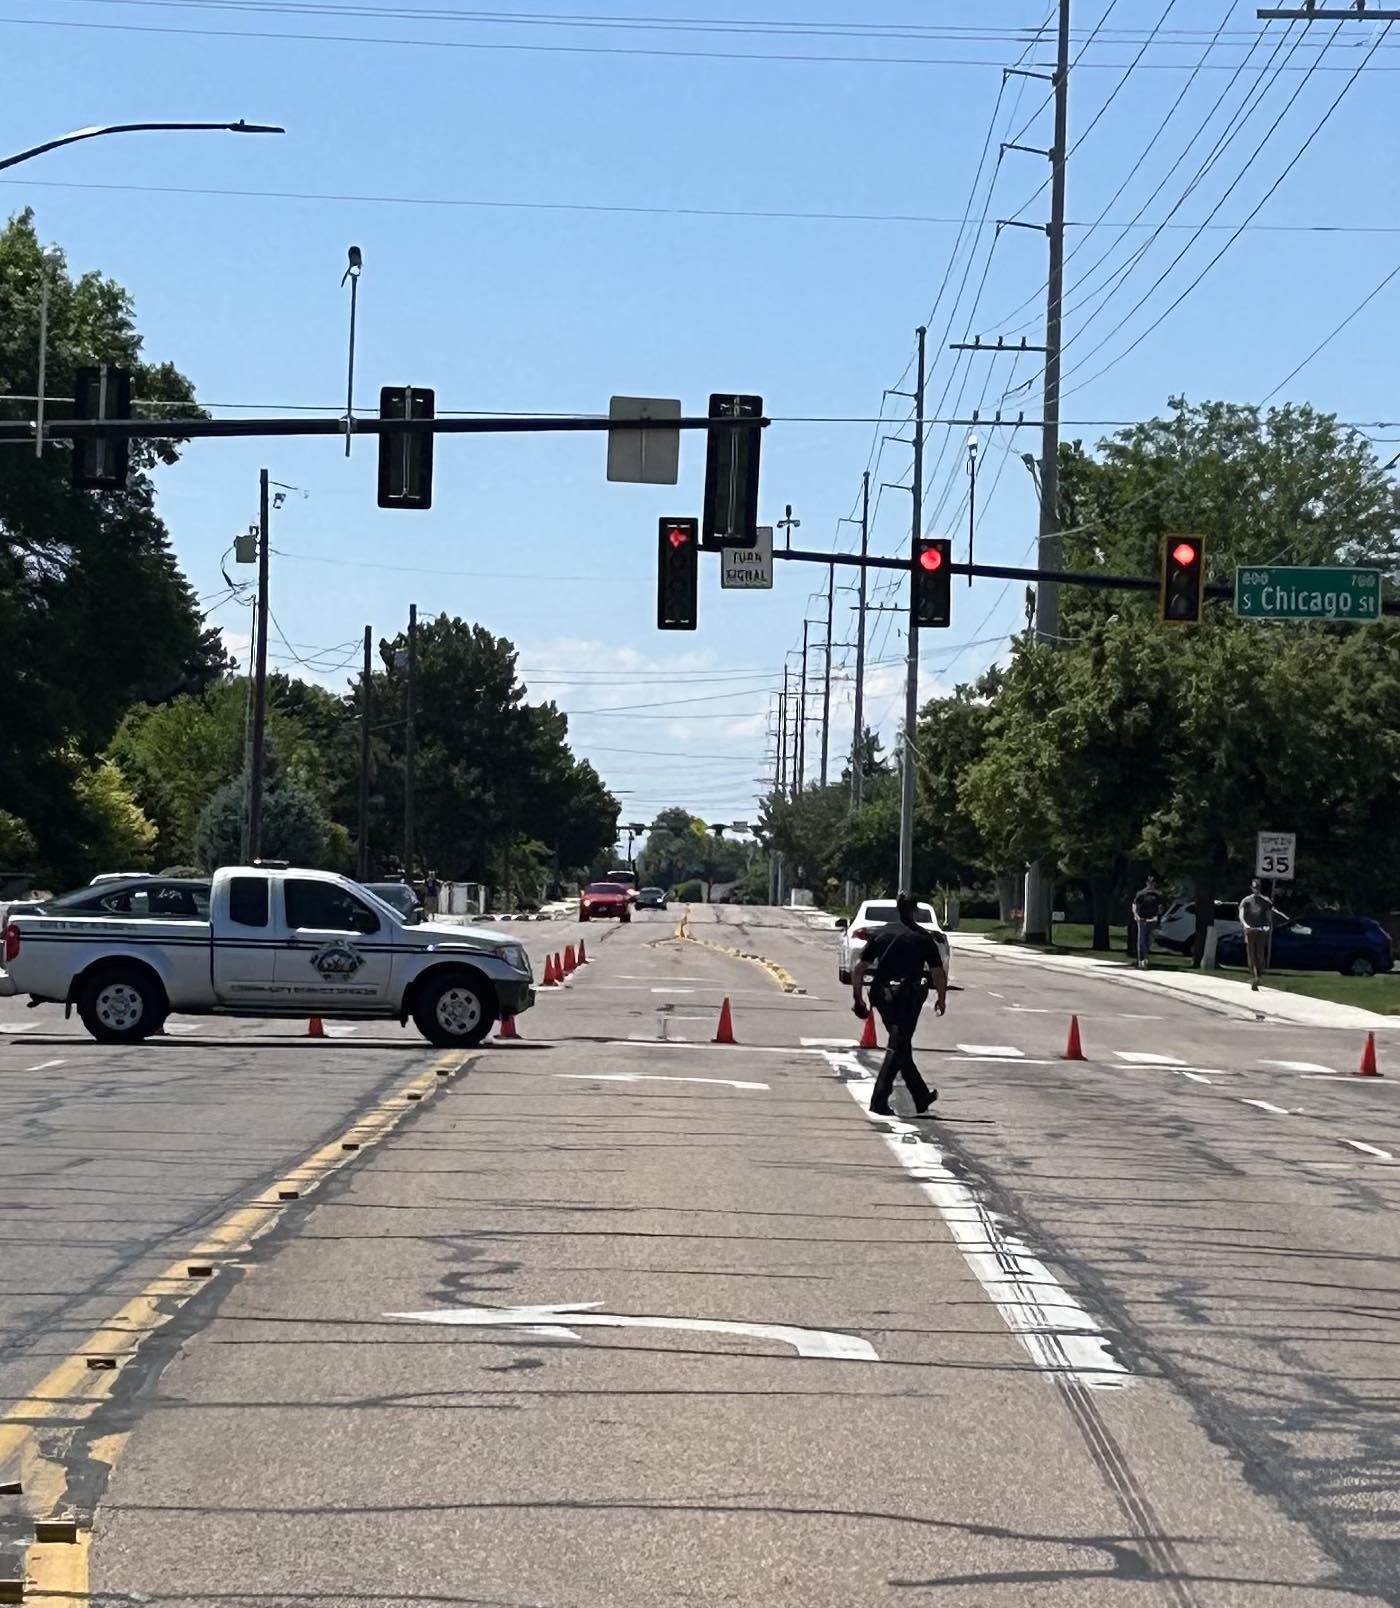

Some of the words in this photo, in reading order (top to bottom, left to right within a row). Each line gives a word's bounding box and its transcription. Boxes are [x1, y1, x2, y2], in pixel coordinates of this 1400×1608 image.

[726, 569, 768, 583] SIGNAL
[1242, 593, 1251, 610] S
[1261, 586, 1352, 618] Chicago
[1262, 856, 1289, 873] 35
